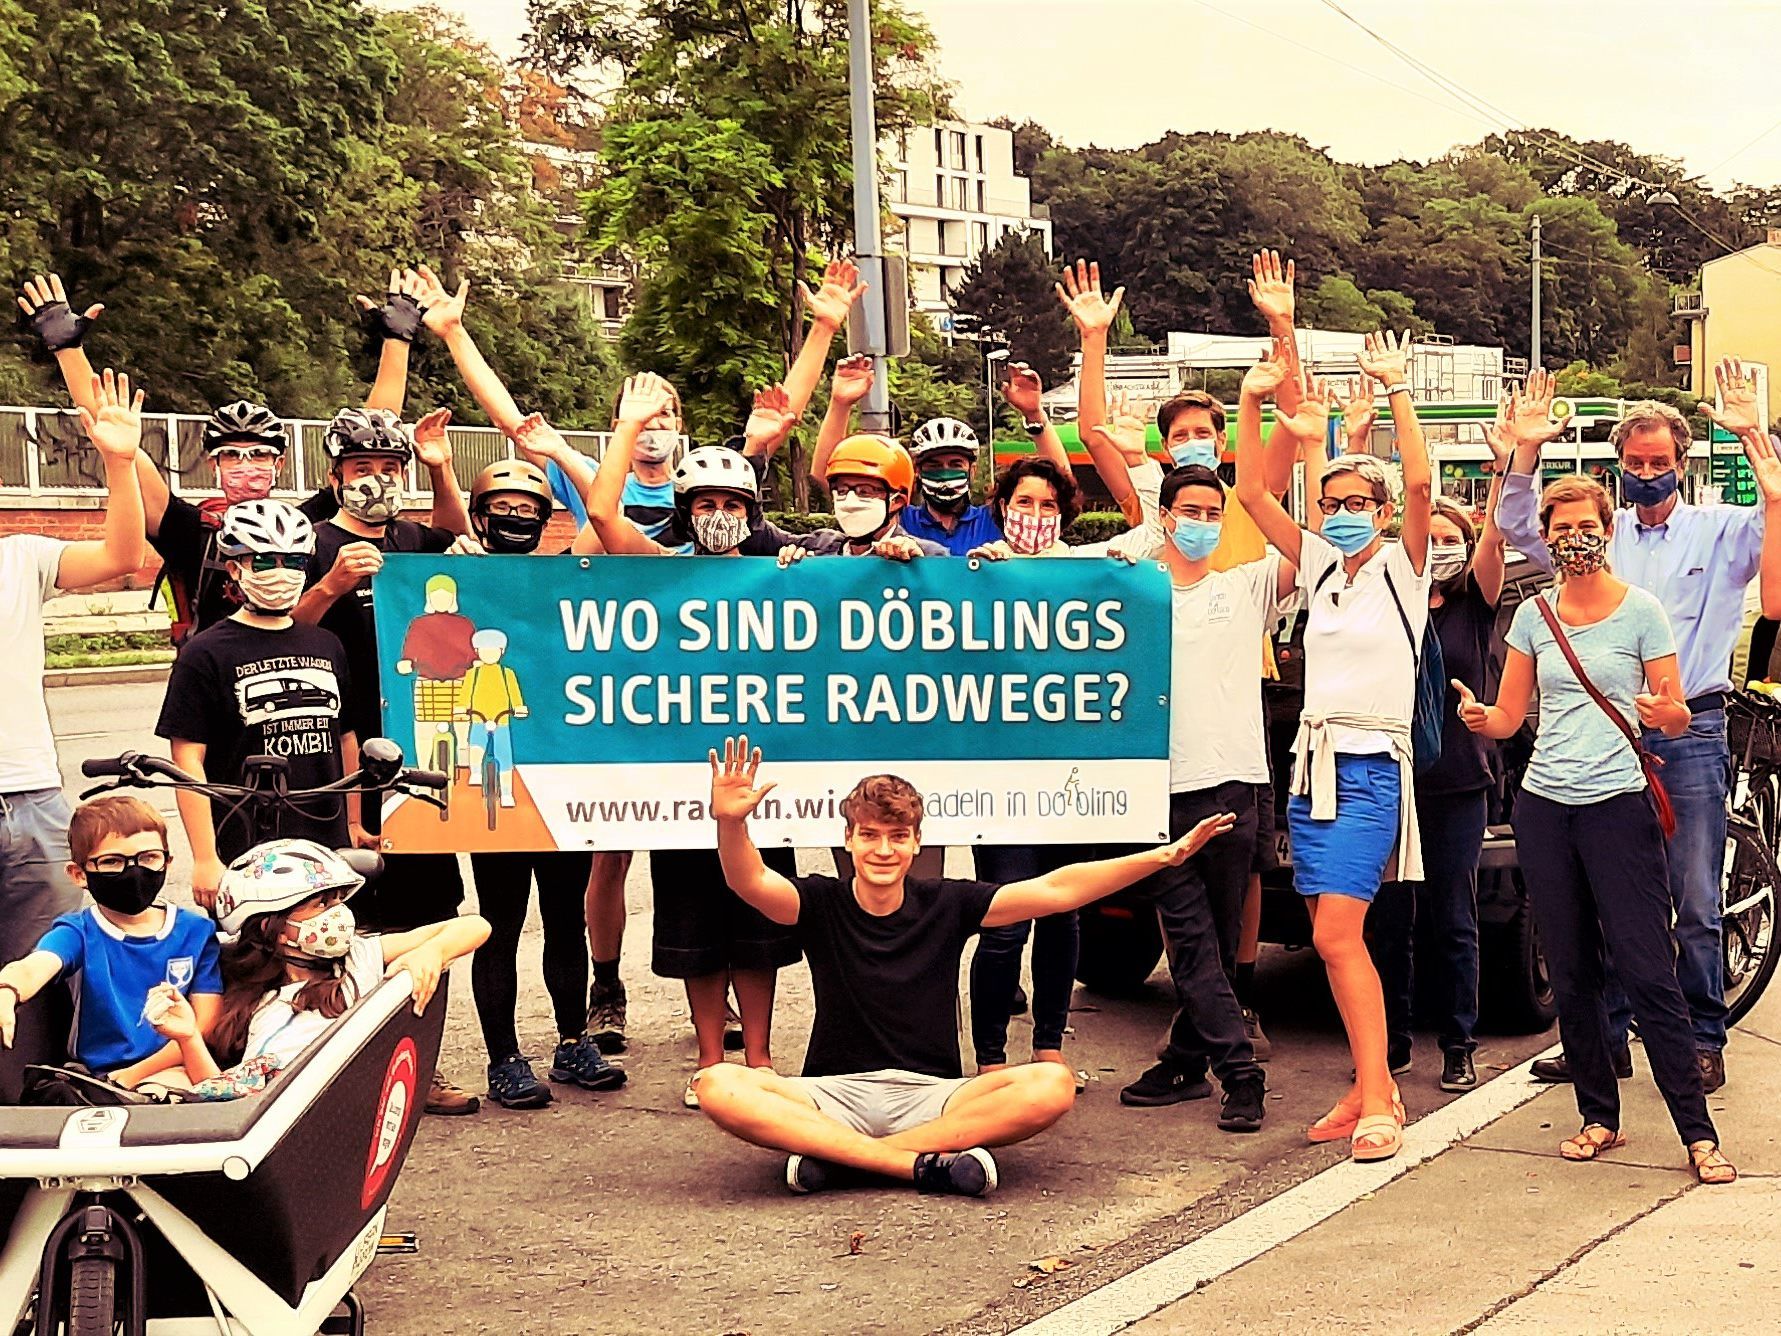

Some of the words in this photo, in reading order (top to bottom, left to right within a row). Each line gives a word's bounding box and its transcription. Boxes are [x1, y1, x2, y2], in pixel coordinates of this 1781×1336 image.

[1541, 460, 1572, 470] ERKUR
[559, 599, 659, 652] WO
[678, 599, 818, 651] SIND
[840, 588, 1126, 652] DÖBLINGS
[236, 662, 259, 678] DER
[257, 656, 299, 673] LETZTE
[564, 674, 805, 725] SICHERE
[827, 673, 1130, 723] RADWEGE?
[262, 722, 279, 736] IST
[263, 731, 334, 758] KOMBI!
[921, 788, 994, 818] adeln
[1006, 791, 1026, 817] in
